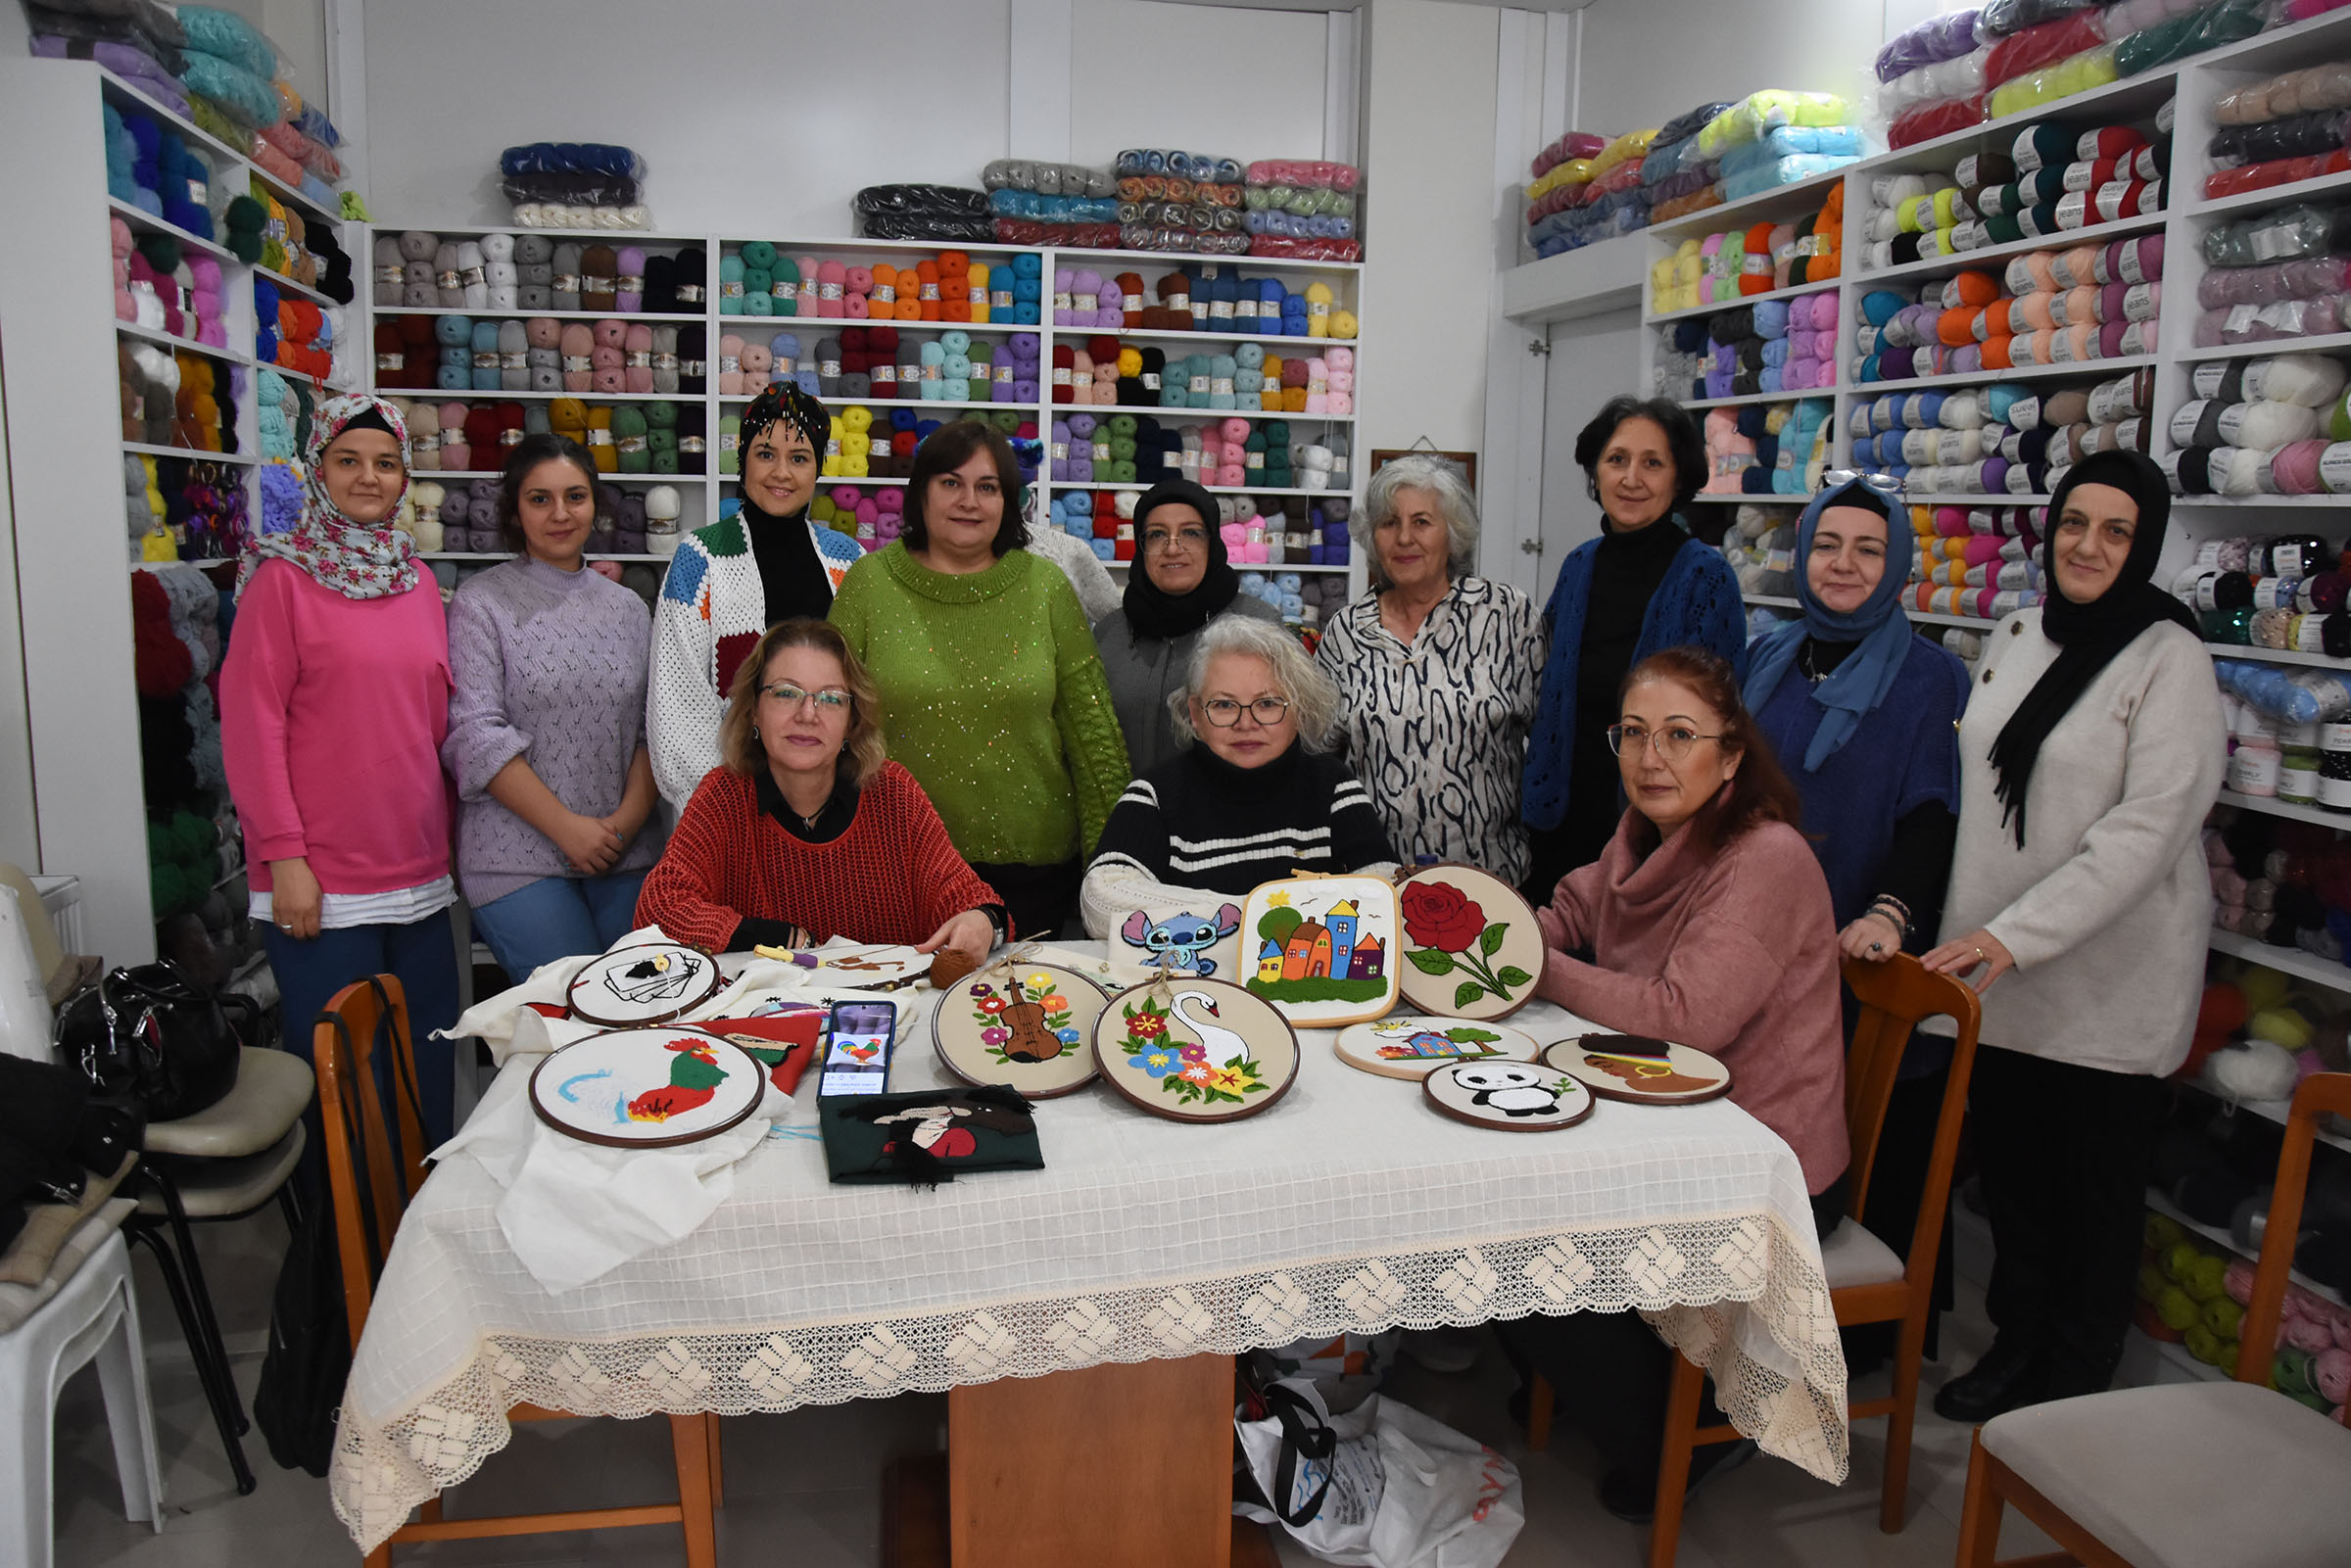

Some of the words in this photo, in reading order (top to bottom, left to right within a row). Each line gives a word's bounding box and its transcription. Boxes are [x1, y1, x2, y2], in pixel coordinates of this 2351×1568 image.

[2067, 173, 2090, 188] jeans
[2058, 207, 2084, 221] jeans
[2126, 297, 2150, 312] jeans
